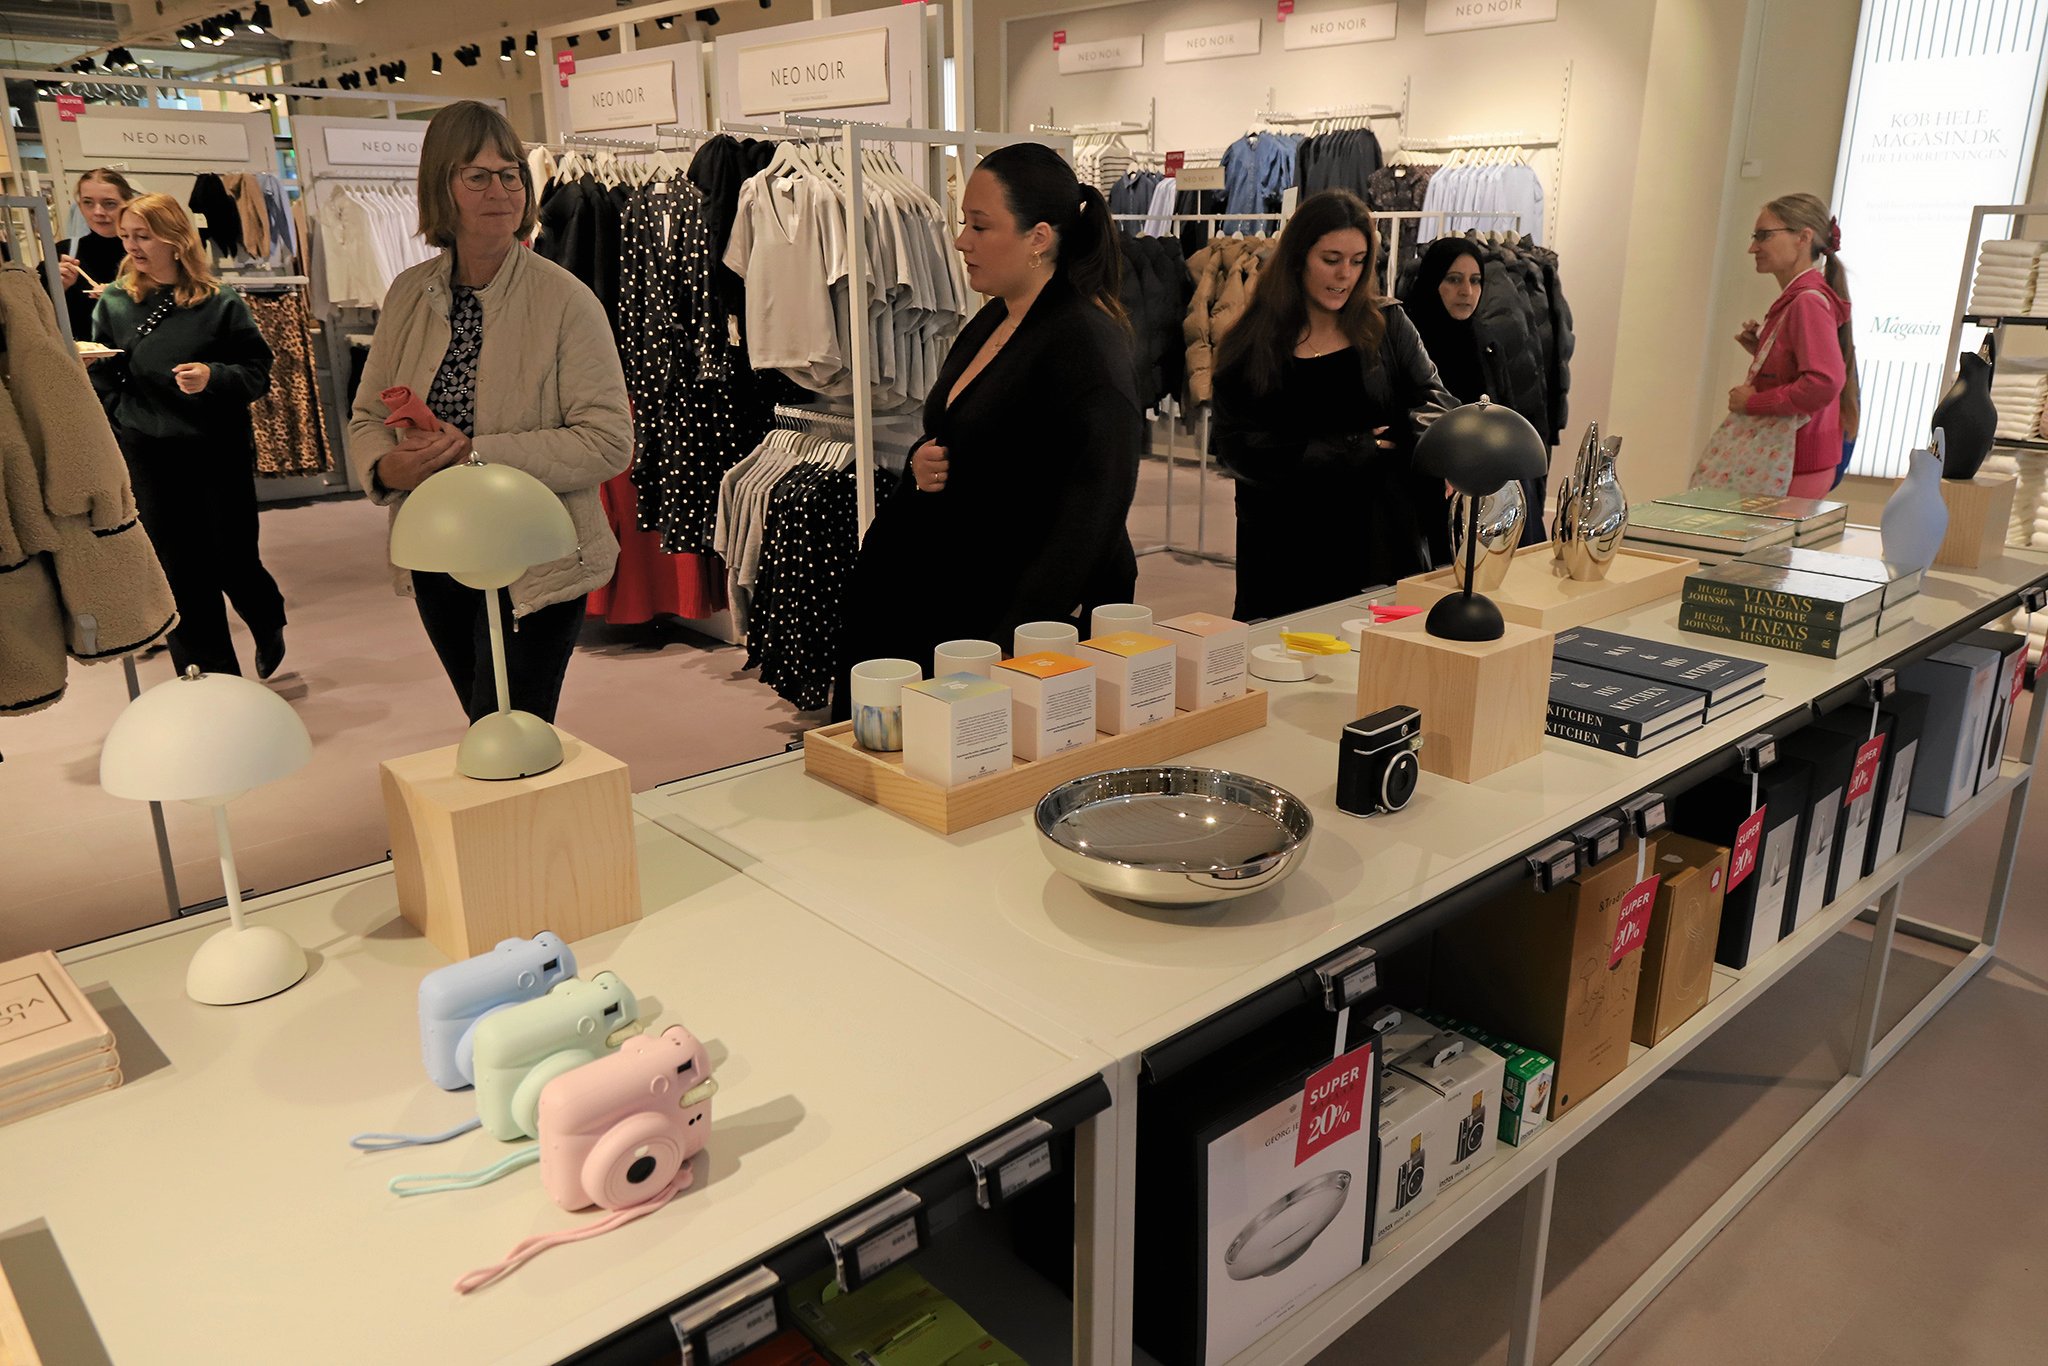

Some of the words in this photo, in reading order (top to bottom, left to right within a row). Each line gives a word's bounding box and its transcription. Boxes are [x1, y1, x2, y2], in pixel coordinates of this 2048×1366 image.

[1455, 4, 1482, 17] NEO
[1488, 0, 1522, 13] NOIR
[1310, 21, 1334, 35] NEO
[1338, 18, 1367, 31] NOIR
[1186, 38, 1206, 48] NEO
[1210, 35, 1235, 46] NOIR
[1078, 51, 1097, 62] NEO
[1099, 48, 1121, 59] NOIR
[770, 66, 801, 86] NEO
[806, 61, 845, 82] NOIR
[592, 91, 614, 108] NEO
[617, 87, 645, 105] NOIR
[1891, 112, 1930, 129] KØB
[1936, 108, 1989, 126] HELE
[122, 132, 158, 144] NEO
[165, 133, 208, 146] NOIR
[362, 141, 392, 152] NEO
[1871, 128, 2001, 149] MAGASIN.DK
[1870, 316, 1941, 341] Magasin
[1688, 592, 1736, 607] JOHNSON
[1697, 584, 1728, 596] HUGH
[1744, 588, 1814, 614] VINENS
[1694, 611, 1725, 624] HUGH
[1744, 603, 1807, 624] HISTORIE
[1684, 619, 1732, 634] JOHNSON
[1740, 615, 1809, 641] VINENS
[1604, 645, 1636, 657] MAN
[1740, 631, 1803, 651] HISTORIE
[1661, 656, 1689, 668] HIS
[1678, 657, 1732, 680] KITCHEN
[1593, 686, 1622, 697] HIS
[1609, 686, 1668, 711] KITCHEN
[1547, 703, 1603, 728] KITCHEN
[1545, 721, 1600, 745] KITCHEN
[1856, 748, 1878, 768] SUPER
[1849, 769, 1869, 794] 20%
[1738, 821, 1760, 847] SUPER
[1733, 848, 1753, 878] 20%
[1620, 892, 1650, 921] SUPER
[1614, 918, 1640, 953] 20%
[1310, 1066, 1360, 1105] SUPER
[1307, 1101, 1351, 1145] 20%
[1264, 1127, 1292, 1147] GEORG
